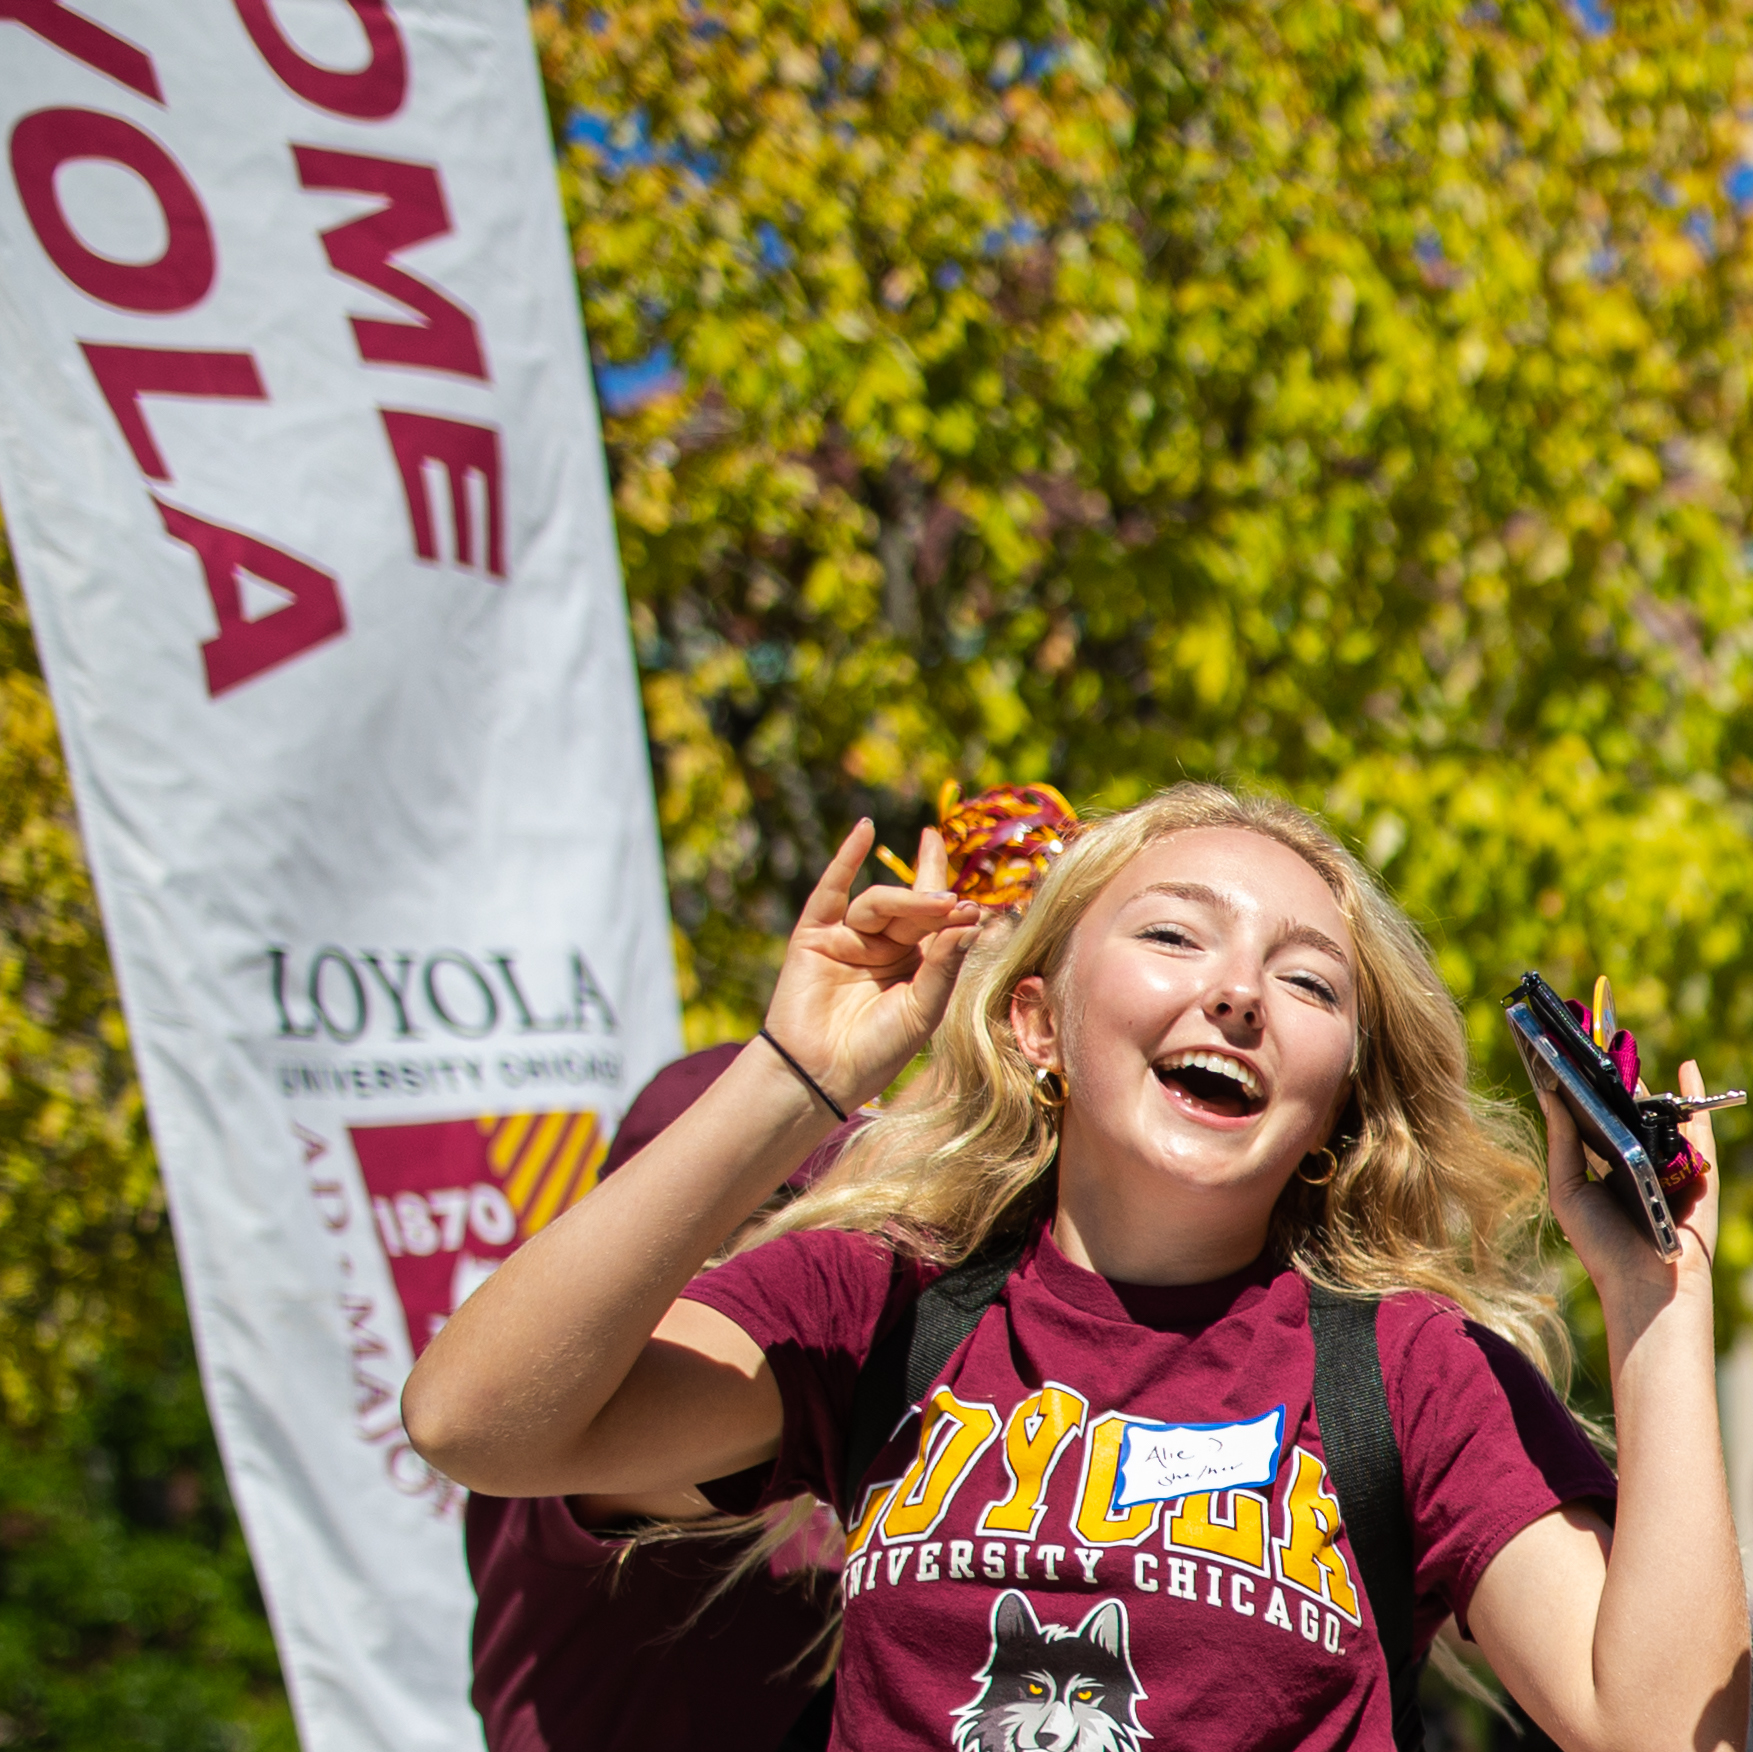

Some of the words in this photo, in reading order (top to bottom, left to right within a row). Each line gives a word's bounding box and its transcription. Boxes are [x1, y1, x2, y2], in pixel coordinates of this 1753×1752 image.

[266, 941, 620, 1046] LOYOLA
[280, 1058, 484, 1098] UNIVERSITY
[372, 1182, 516, 1257] 1870
[1133, 1552, 1341, 1655] CHICAGO
